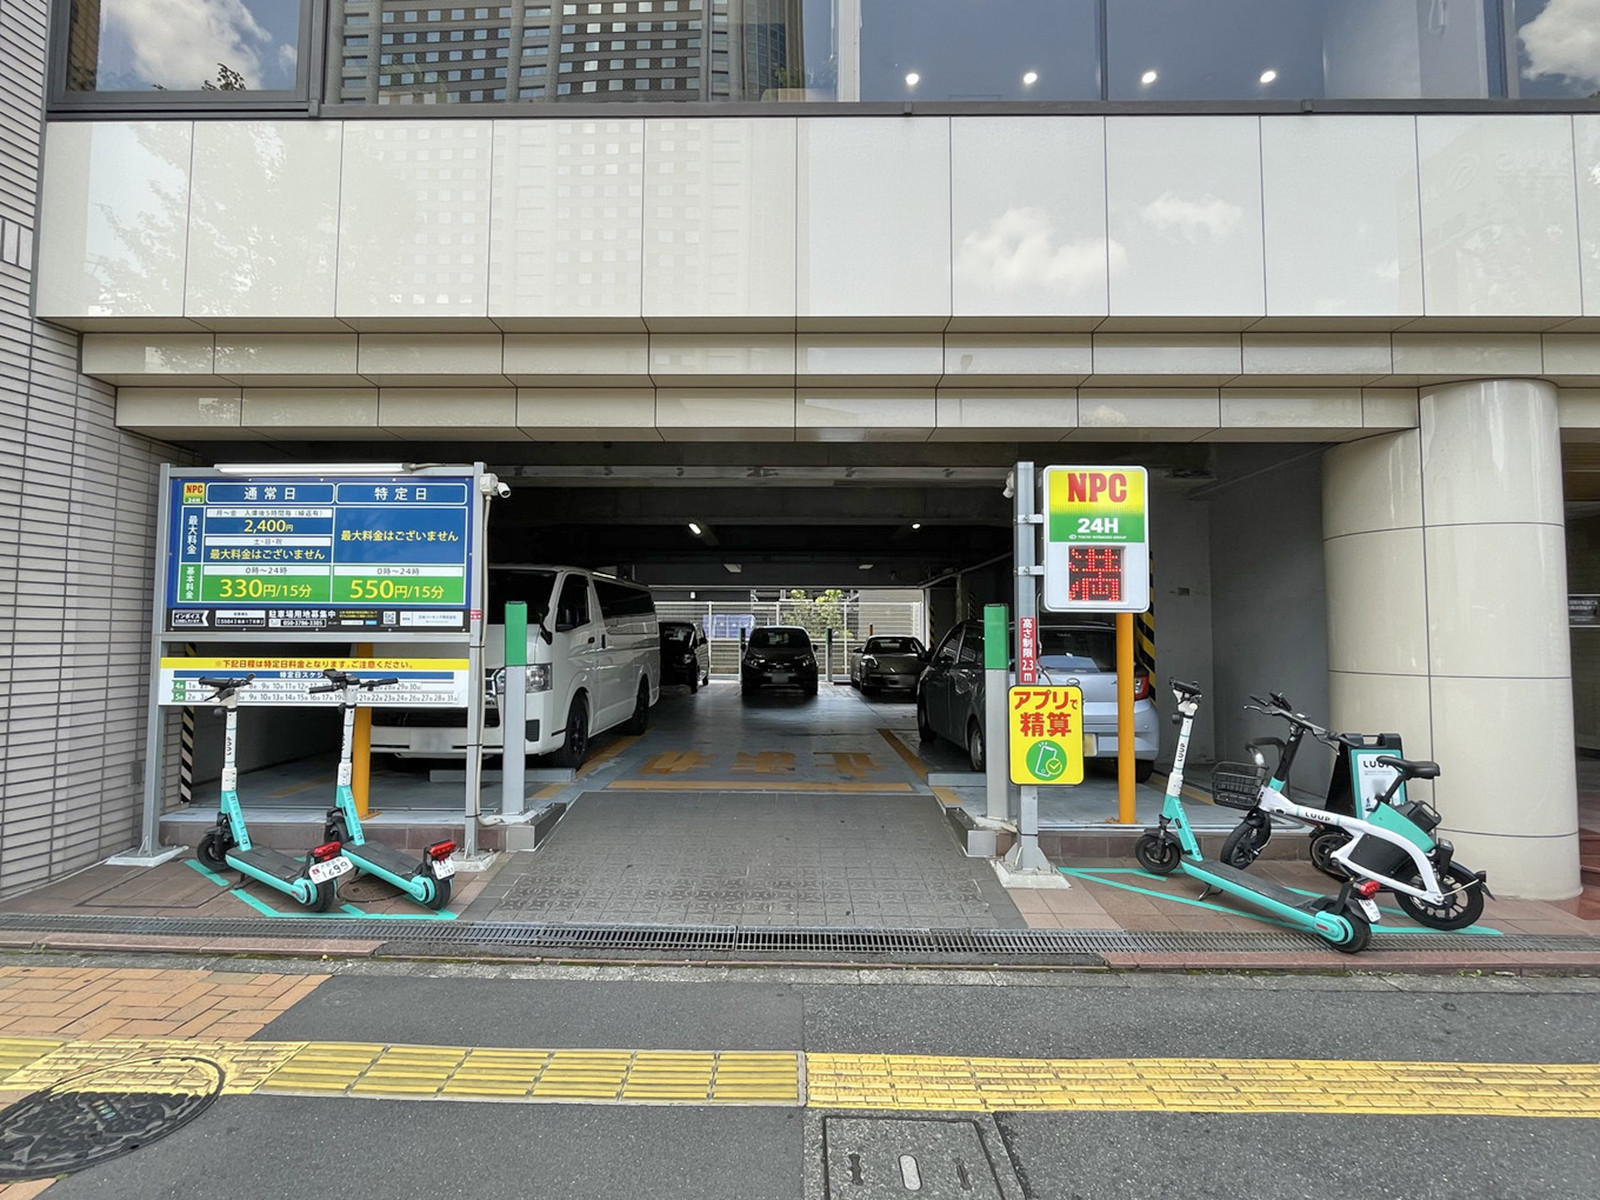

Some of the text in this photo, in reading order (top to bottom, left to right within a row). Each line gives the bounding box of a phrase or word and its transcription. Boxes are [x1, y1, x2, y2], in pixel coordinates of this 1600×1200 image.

[186, 485, 203, 494] NPC
[244, 487, 296, 500] 通常日
[374, 487, 427, 501] 特定日
[1067, 473, 1127, 503] NPC
[187, 515, 198, 555] 最大料金
[243, 519, 294, 534] 2,400円
[1077, 517, 1119, 534] 24H
[341, 530, 459, 542] 最大料金はございません
[210, 549, 325, 560] 最大料金はございません
[185, 566, 195, 600] 基本料金
[1069, 548, 1122, 602] 満
[219, 578, 312, 598] 330円/15分
[350, 579, 445, 599] 550円/15分
[1014, 690, 1078, 710] アプリで
[1020, 712, 1072, 737] 精算
[1177, 743, 1186, 762] LUUP
[1305, 812, 1330, 821] LUUP
